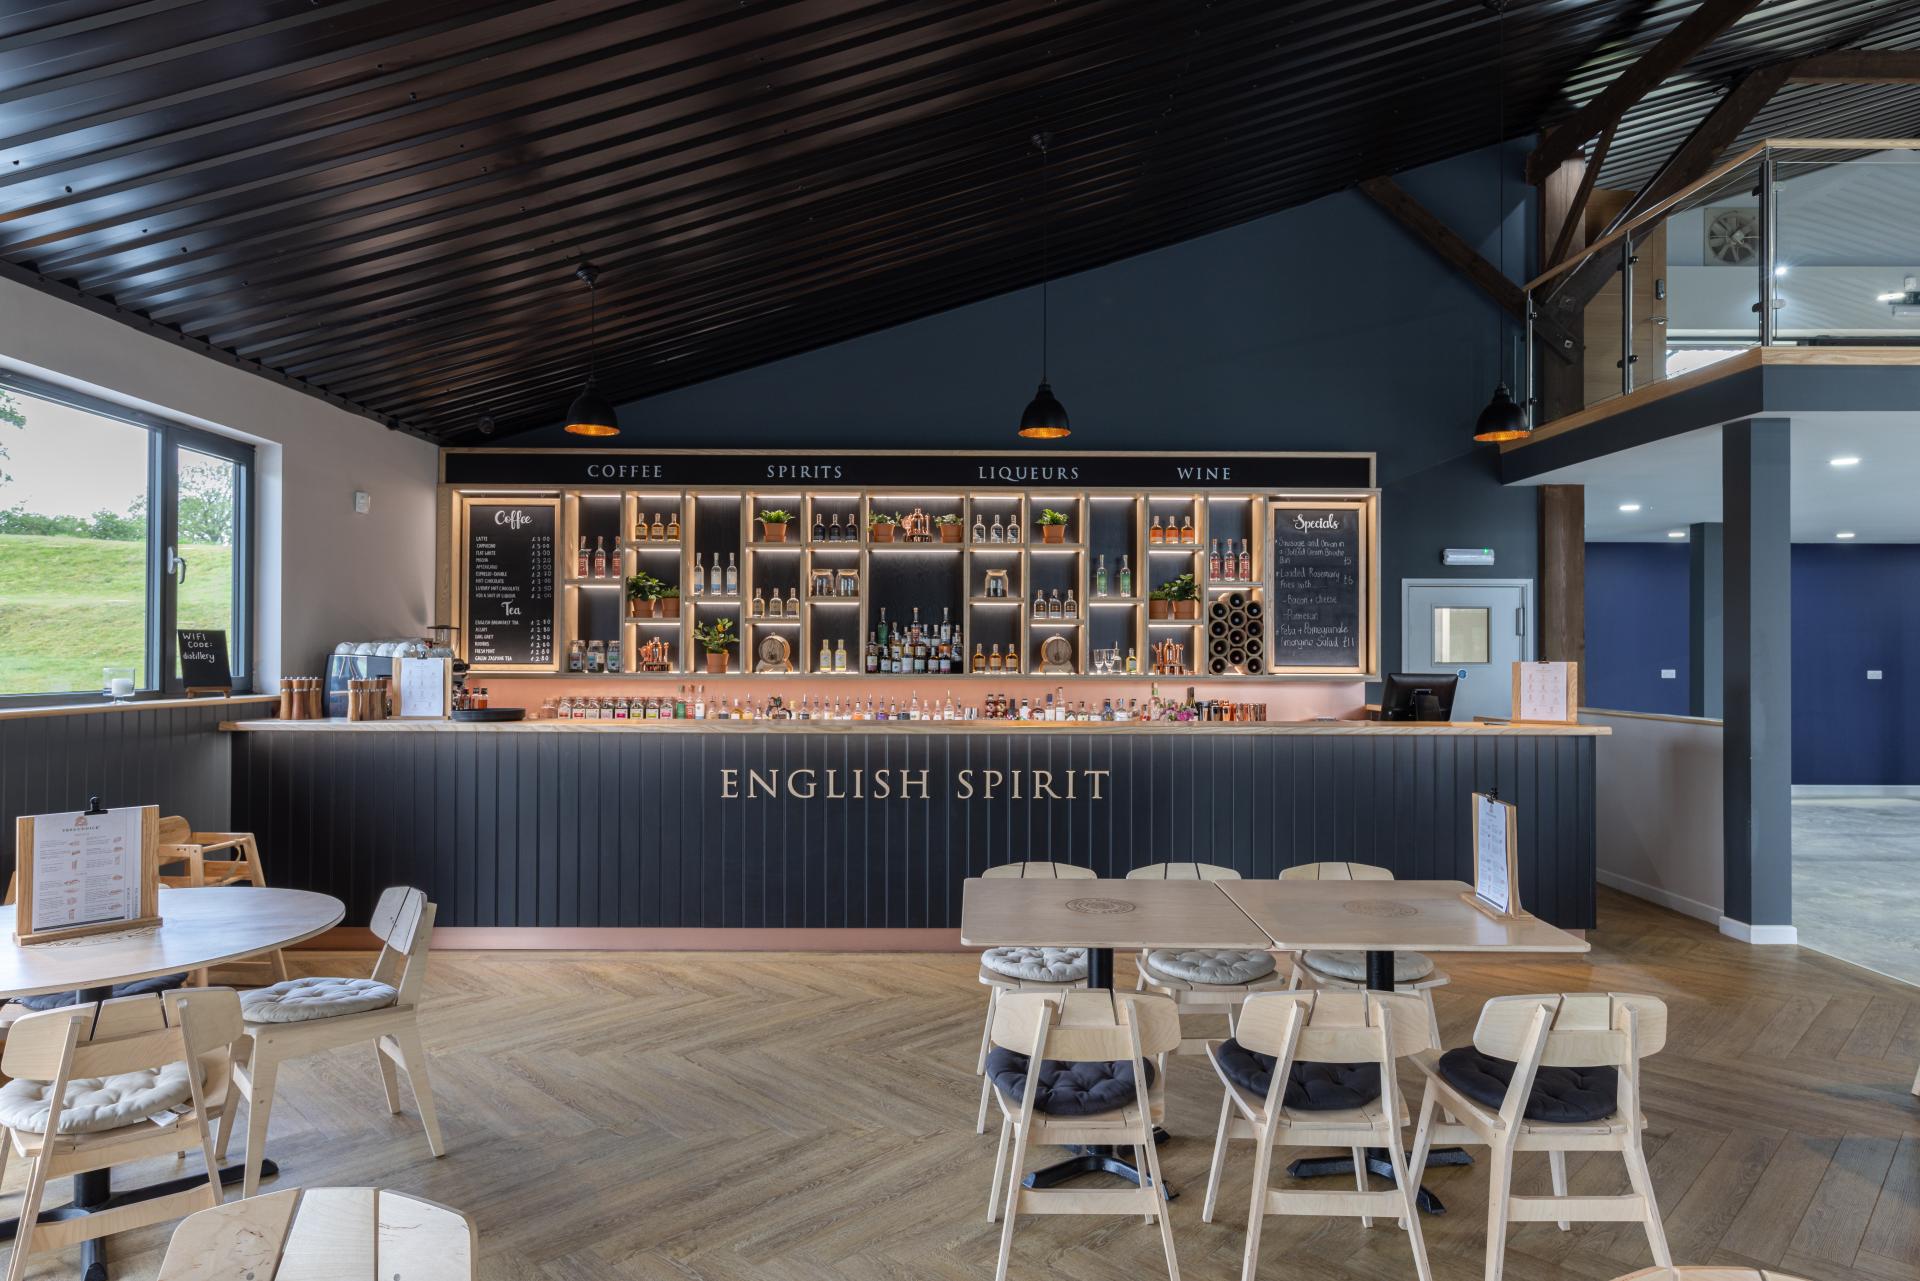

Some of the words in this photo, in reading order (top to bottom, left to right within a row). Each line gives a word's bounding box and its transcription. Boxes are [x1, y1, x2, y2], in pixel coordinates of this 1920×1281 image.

[587, 464, 662, 478] COFFEE
[767, 465, 842, 478] SPIRITS
[978, 466, 1079, 482] LIQUEURS
[1177, 467, 1231, 480] WINE
[494, 510, 533, 529] Coffee
[1293, 513, 1339, 534] Specials
[501, 599, 522, 616] Tea
[182, 632, 206, 640] WIFI
[182, 651, 215, 663] distillery
[720, 769, 931, 799] ENGLISH
[957, 769, 1110, 800] SPIRIT
